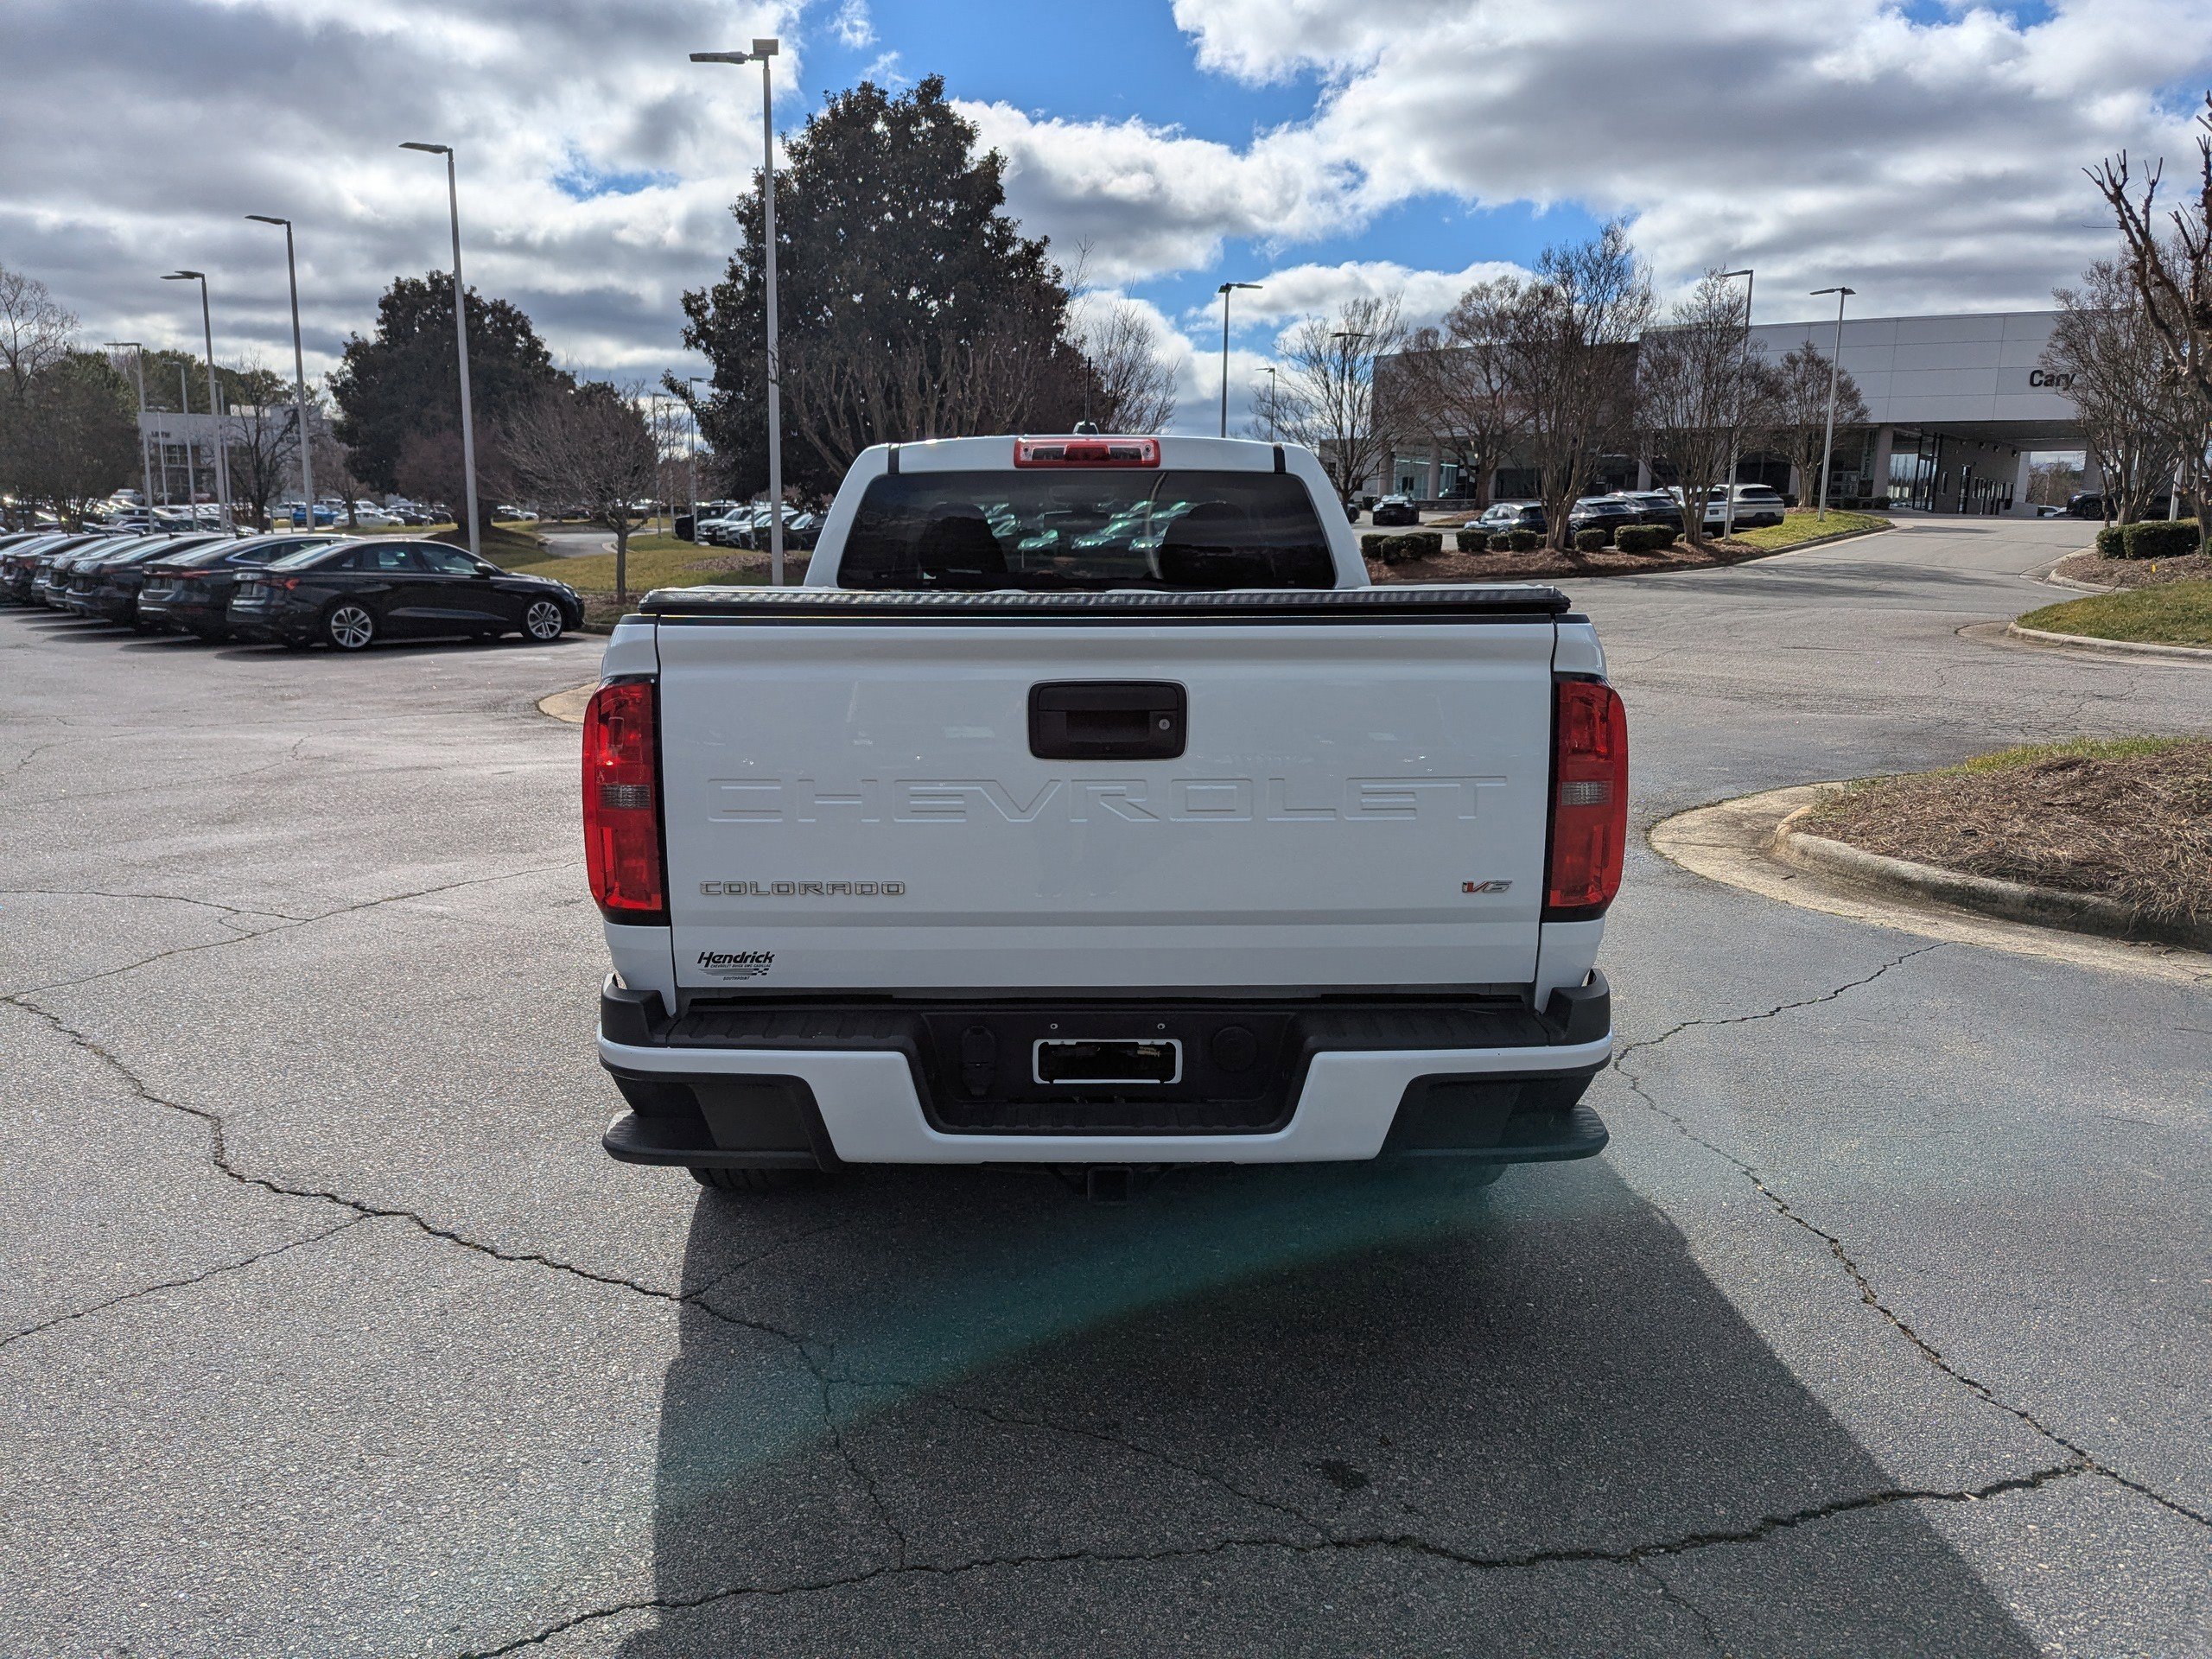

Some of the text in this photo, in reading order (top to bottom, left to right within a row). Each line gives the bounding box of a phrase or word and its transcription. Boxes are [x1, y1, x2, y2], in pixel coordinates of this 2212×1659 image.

[2029, 369, 2076, 391] Cary
[707, 776, 1507, 822] CHEVROLET
[700, 880, 906, 895] COLORADO
[697, 950, 775, 968] Hendrick
